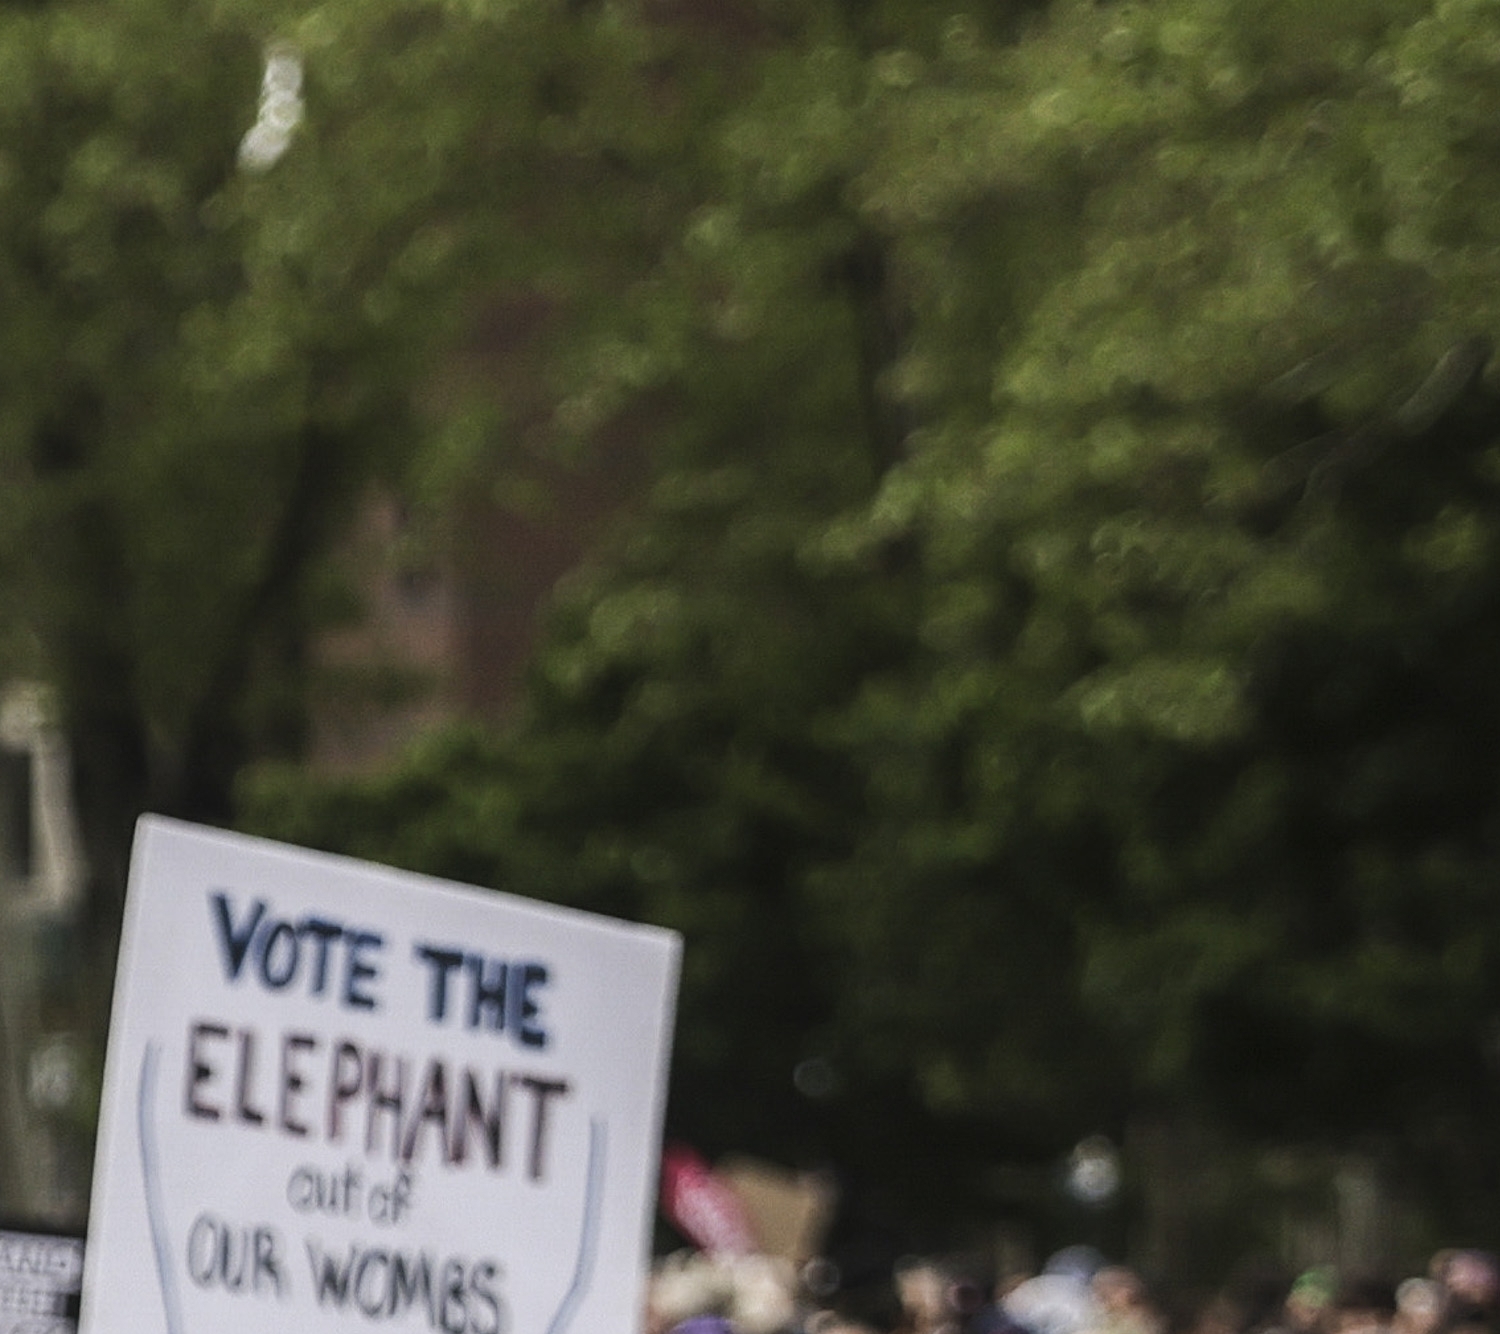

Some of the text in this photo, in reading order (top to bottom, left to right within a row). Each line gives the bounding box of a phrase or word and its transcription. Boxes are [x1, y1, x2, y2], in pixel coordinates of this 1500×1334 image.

[211, 890, 556, 1051] VOTE THE
[180, 1019, 569, 1182] ELEPHANT
[288, 1165, 363, 1214] out
[185, 1212, 294, 1303] OUR
